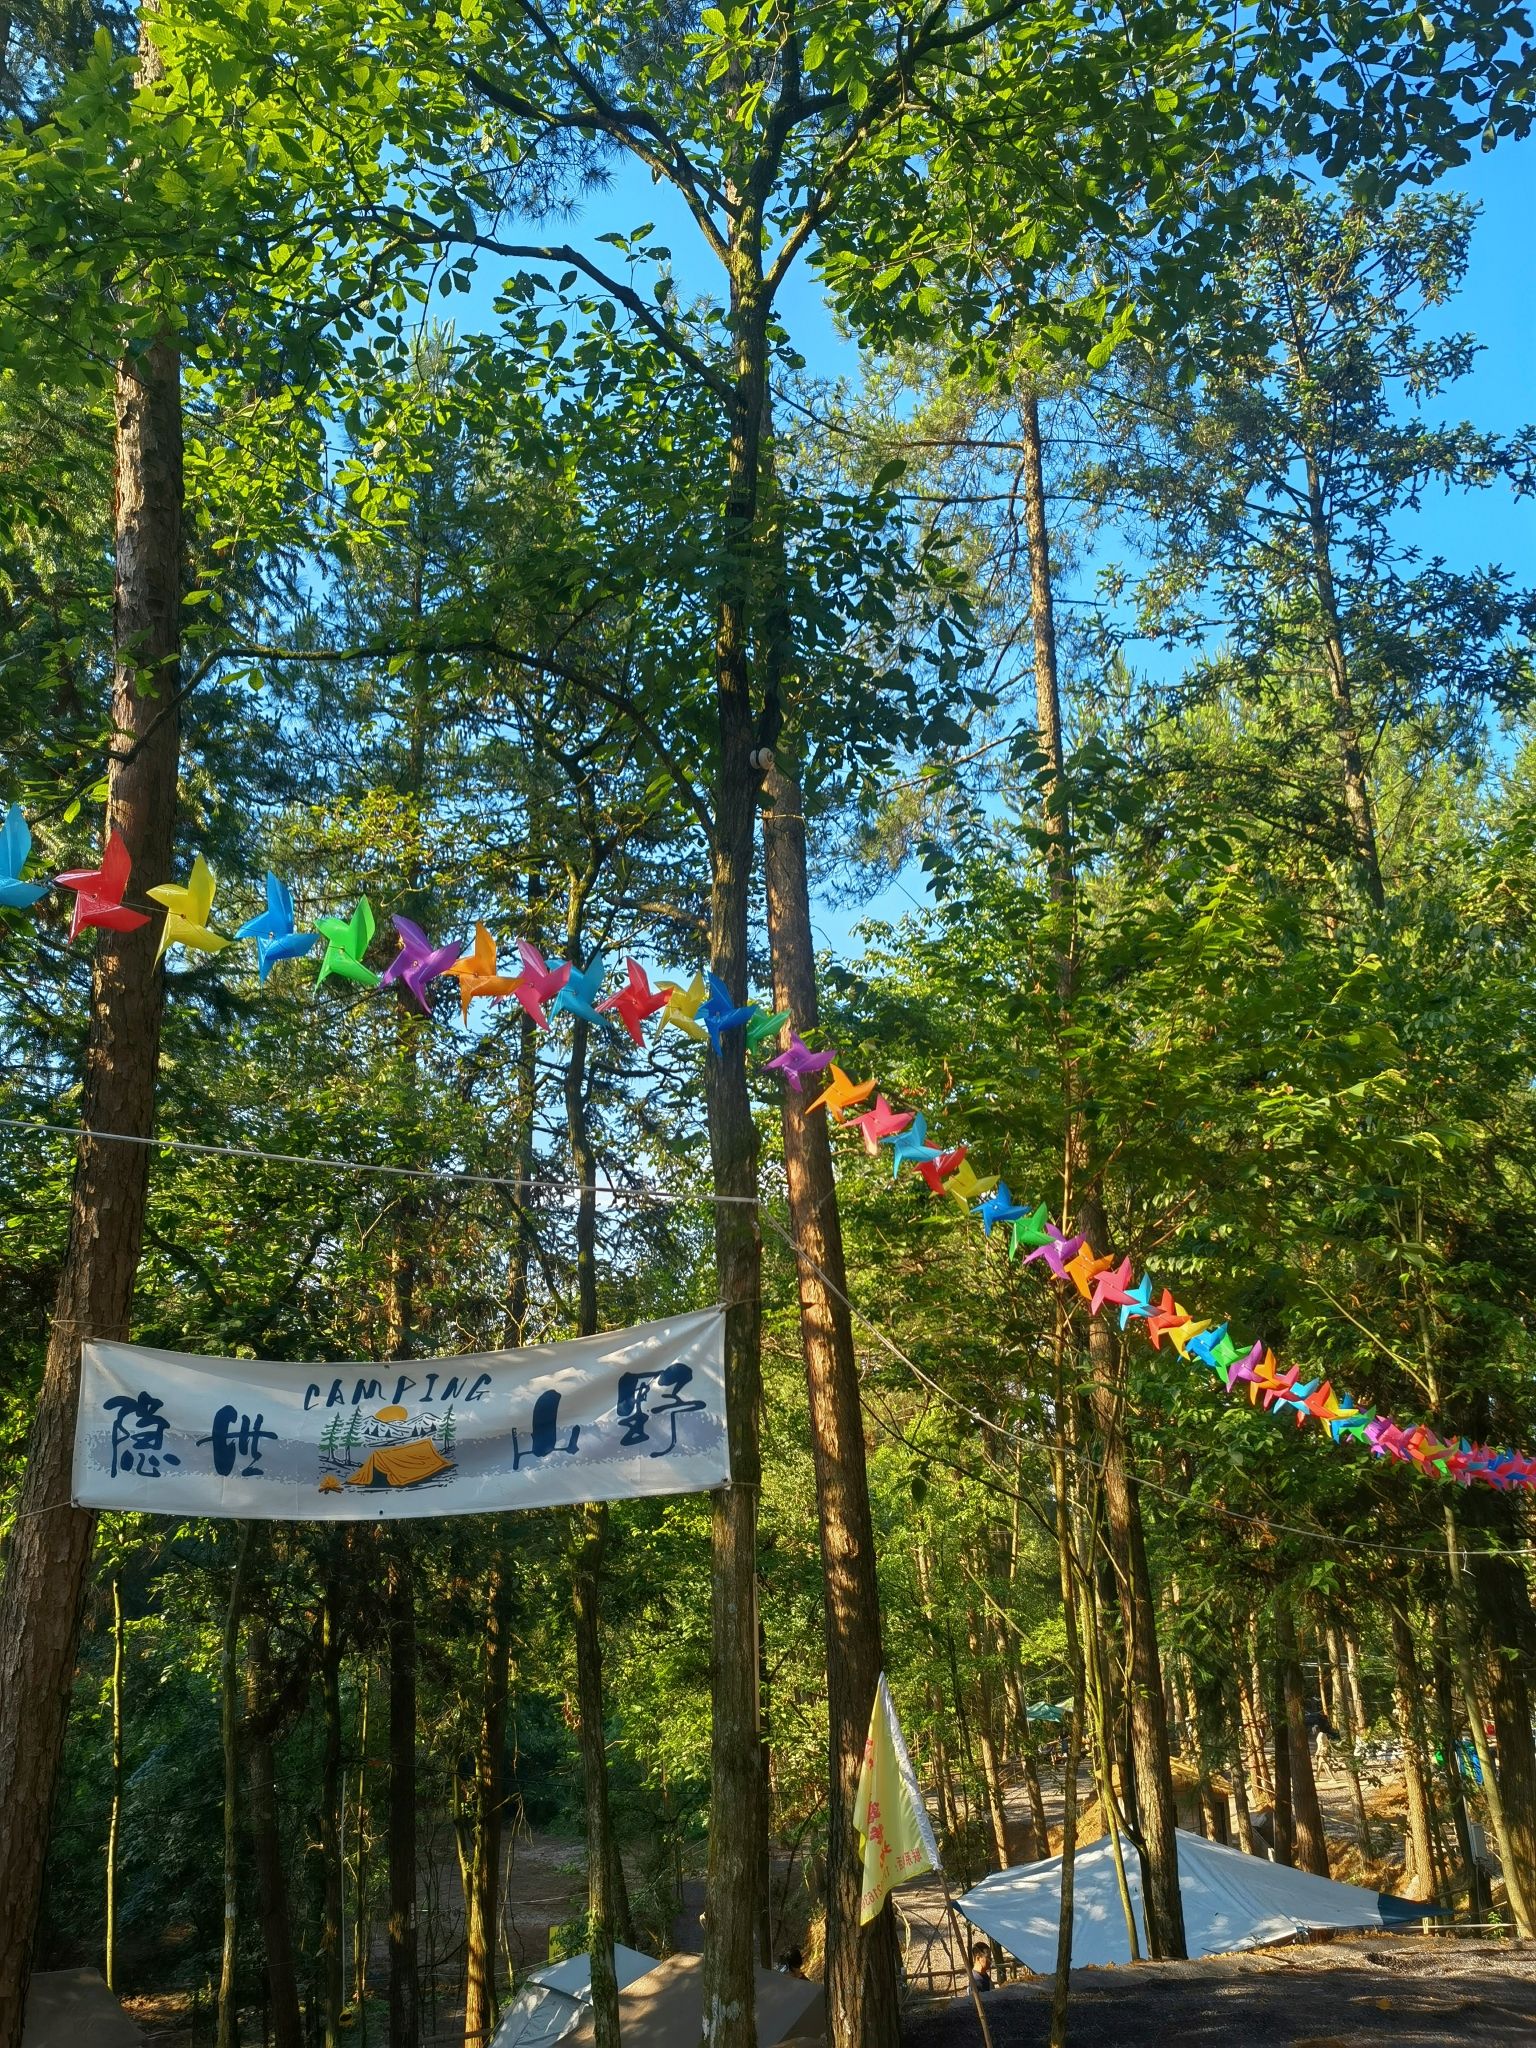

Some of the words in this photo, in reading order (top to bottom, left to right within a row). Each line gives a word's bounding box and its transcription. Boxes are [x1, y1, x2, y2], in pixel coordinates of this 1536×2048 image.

[103, 1391, 278, 1478] 隐世
[511, 1363, 707, 1470] 山野
[304, 1373, 492, 1411] CAMPING
